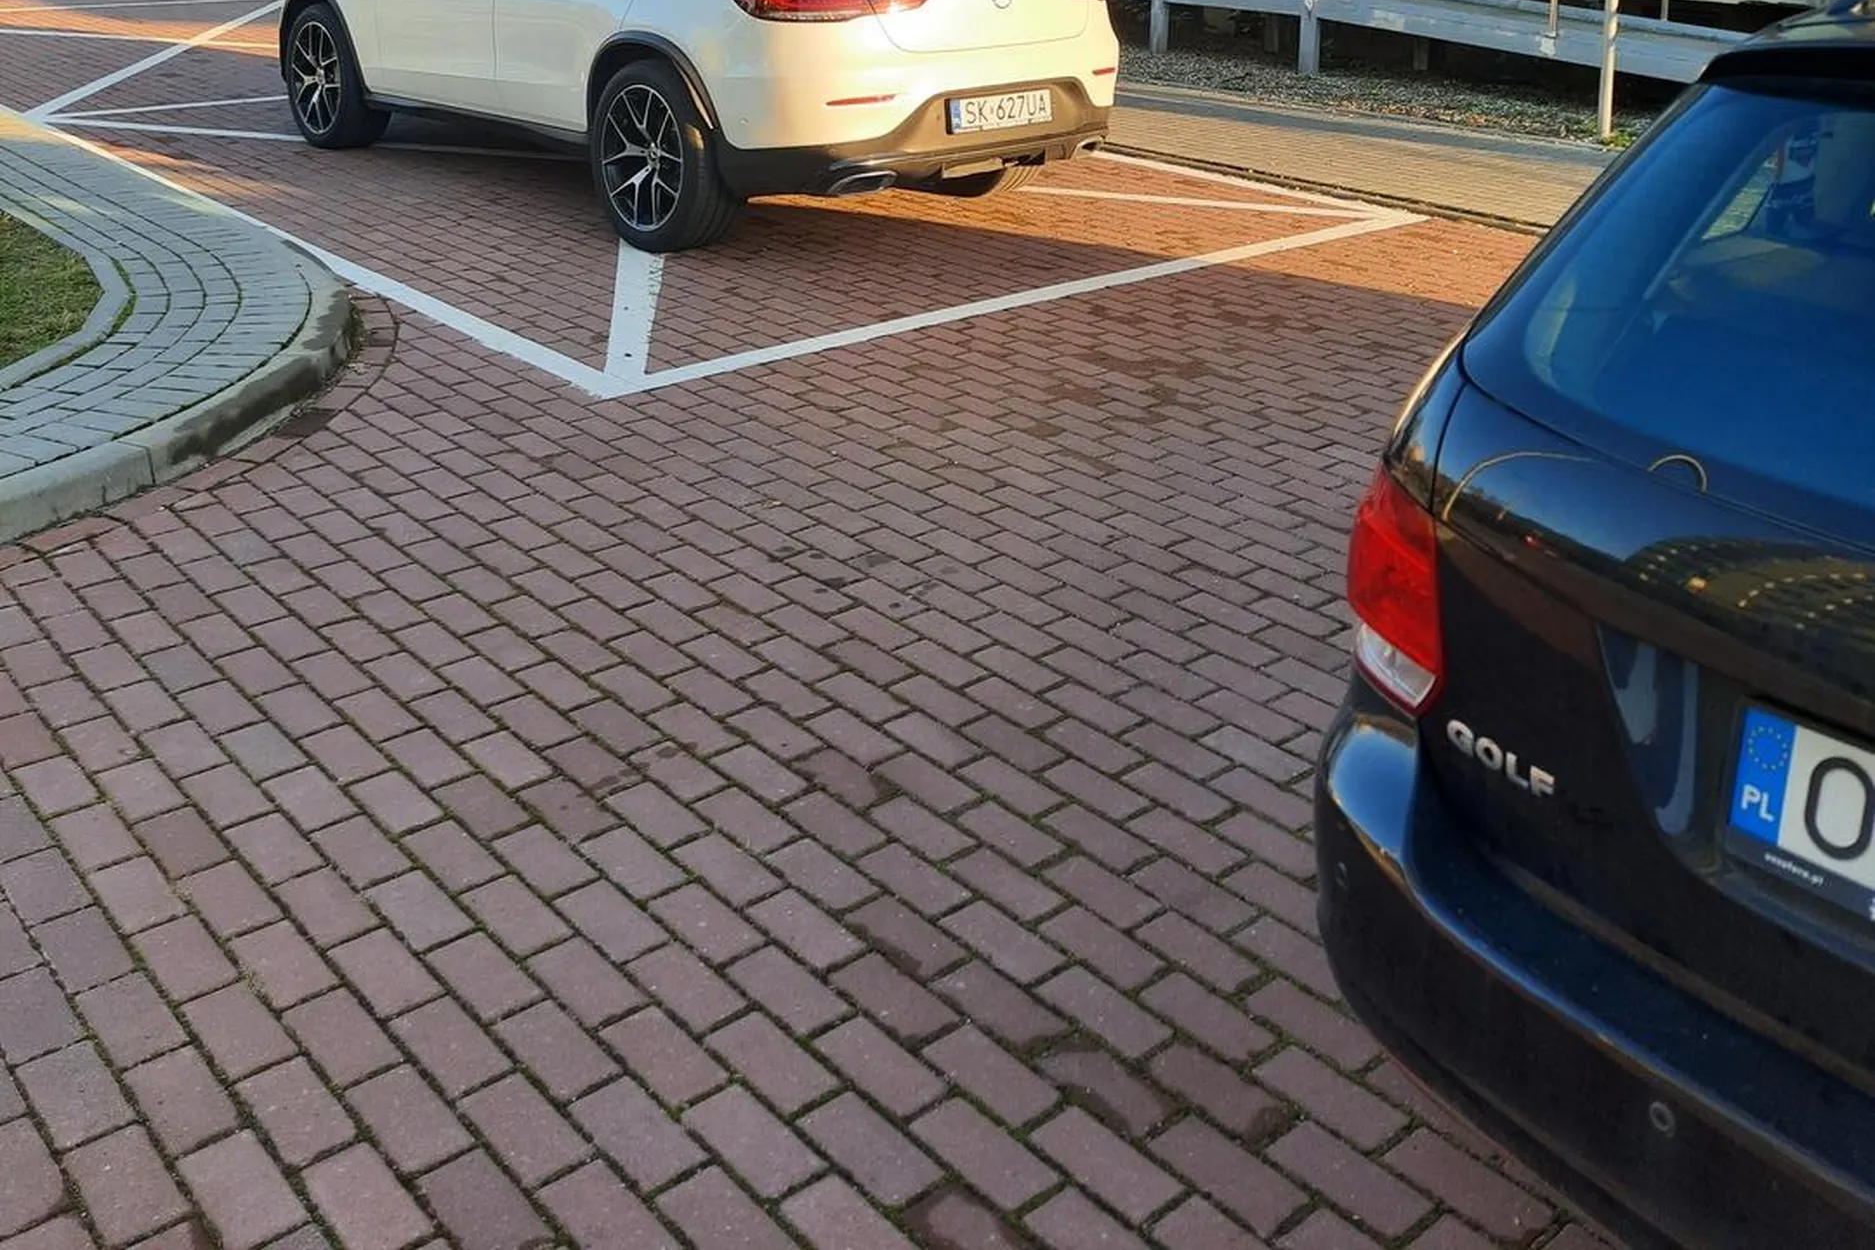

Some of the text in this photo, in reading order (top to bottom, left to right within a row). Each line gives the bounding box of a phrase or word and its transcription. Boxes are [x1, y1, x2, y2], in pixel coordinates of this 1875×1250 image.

[965, 100, 988, 124] SK
[996, 93, 1046, 120] 627UA
[1446, 719, 1555, 798] GOLF
[1741, 784, 1774, 823] PL
